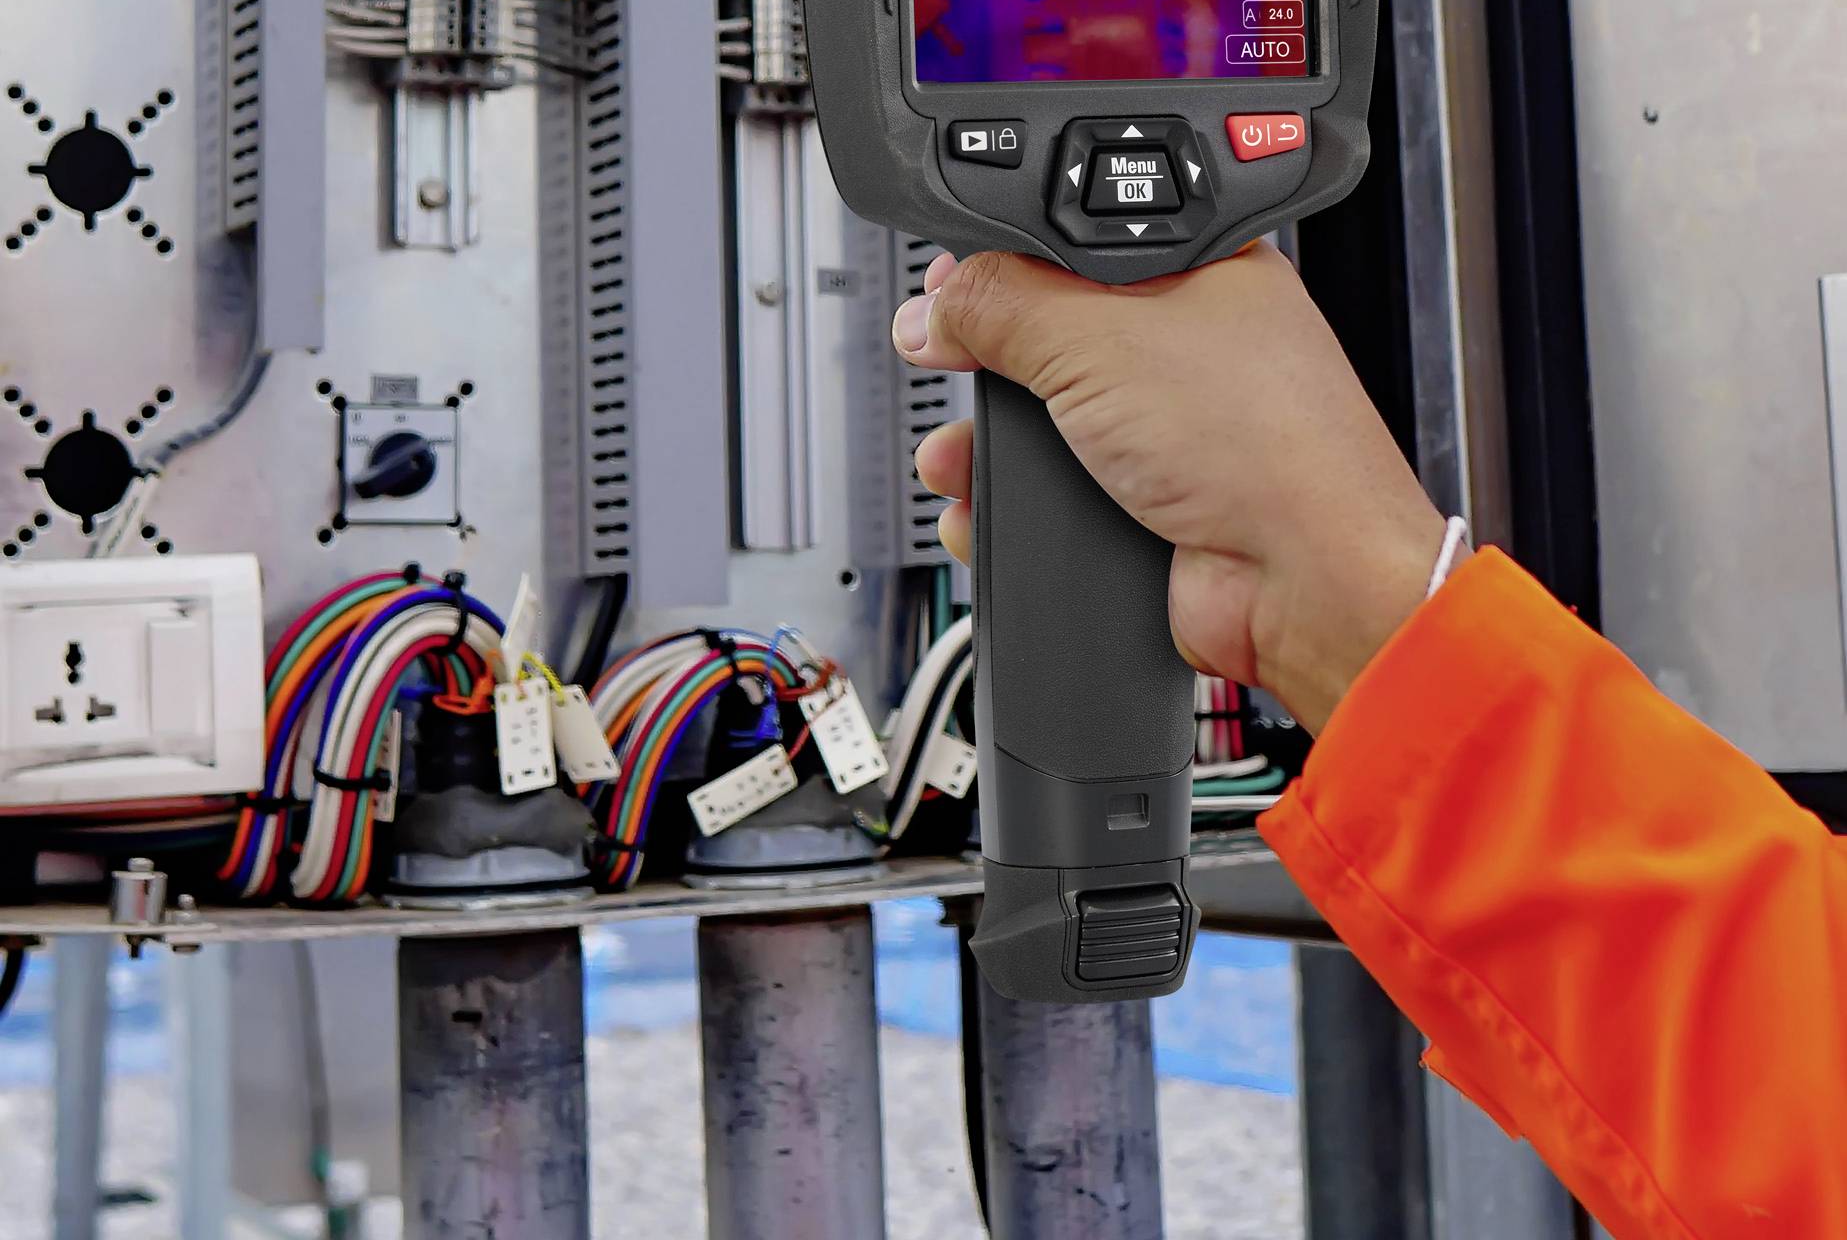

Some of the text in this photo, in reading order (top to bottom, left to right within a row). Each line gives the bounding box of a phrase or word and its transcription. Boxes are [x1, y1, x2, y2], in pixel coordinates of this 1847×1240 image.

[1269, 8, 1294, 20] 24.0
[1240, 41, 1290, 58] AUTO
[1110, 156, 1157, 174] Menu
[1124, 182, 1147, 200] OK
